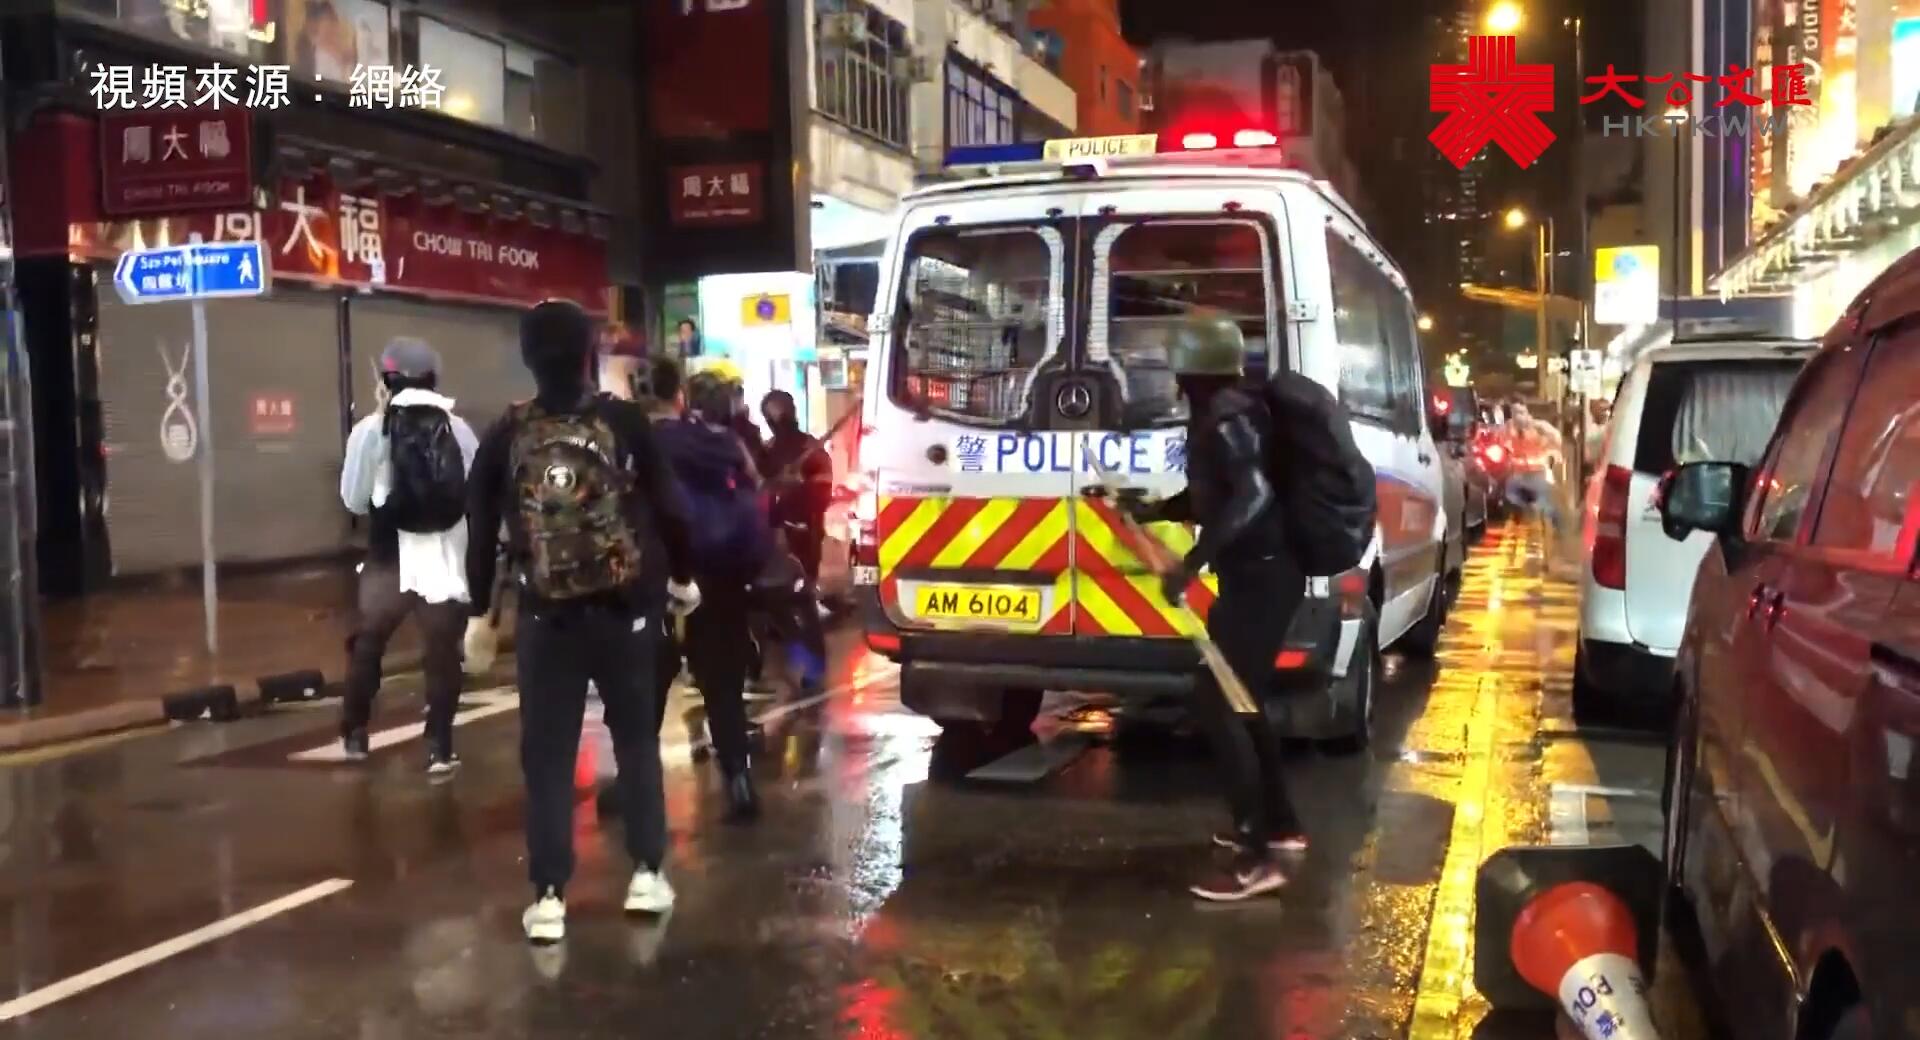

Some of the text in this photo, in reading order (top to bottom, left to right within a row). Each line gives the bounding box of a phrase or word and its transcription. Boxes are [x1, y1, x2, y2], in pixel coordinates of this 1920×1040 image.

[1069, 138, 1129, 157] POLICE
[413, 230, 539, 270] CHOW TAI FOOK
[956, 435, 987, 471] 警
[997, 434, 1150, 472] POLICE
[926, 591, 1029, 617] AM 6104
